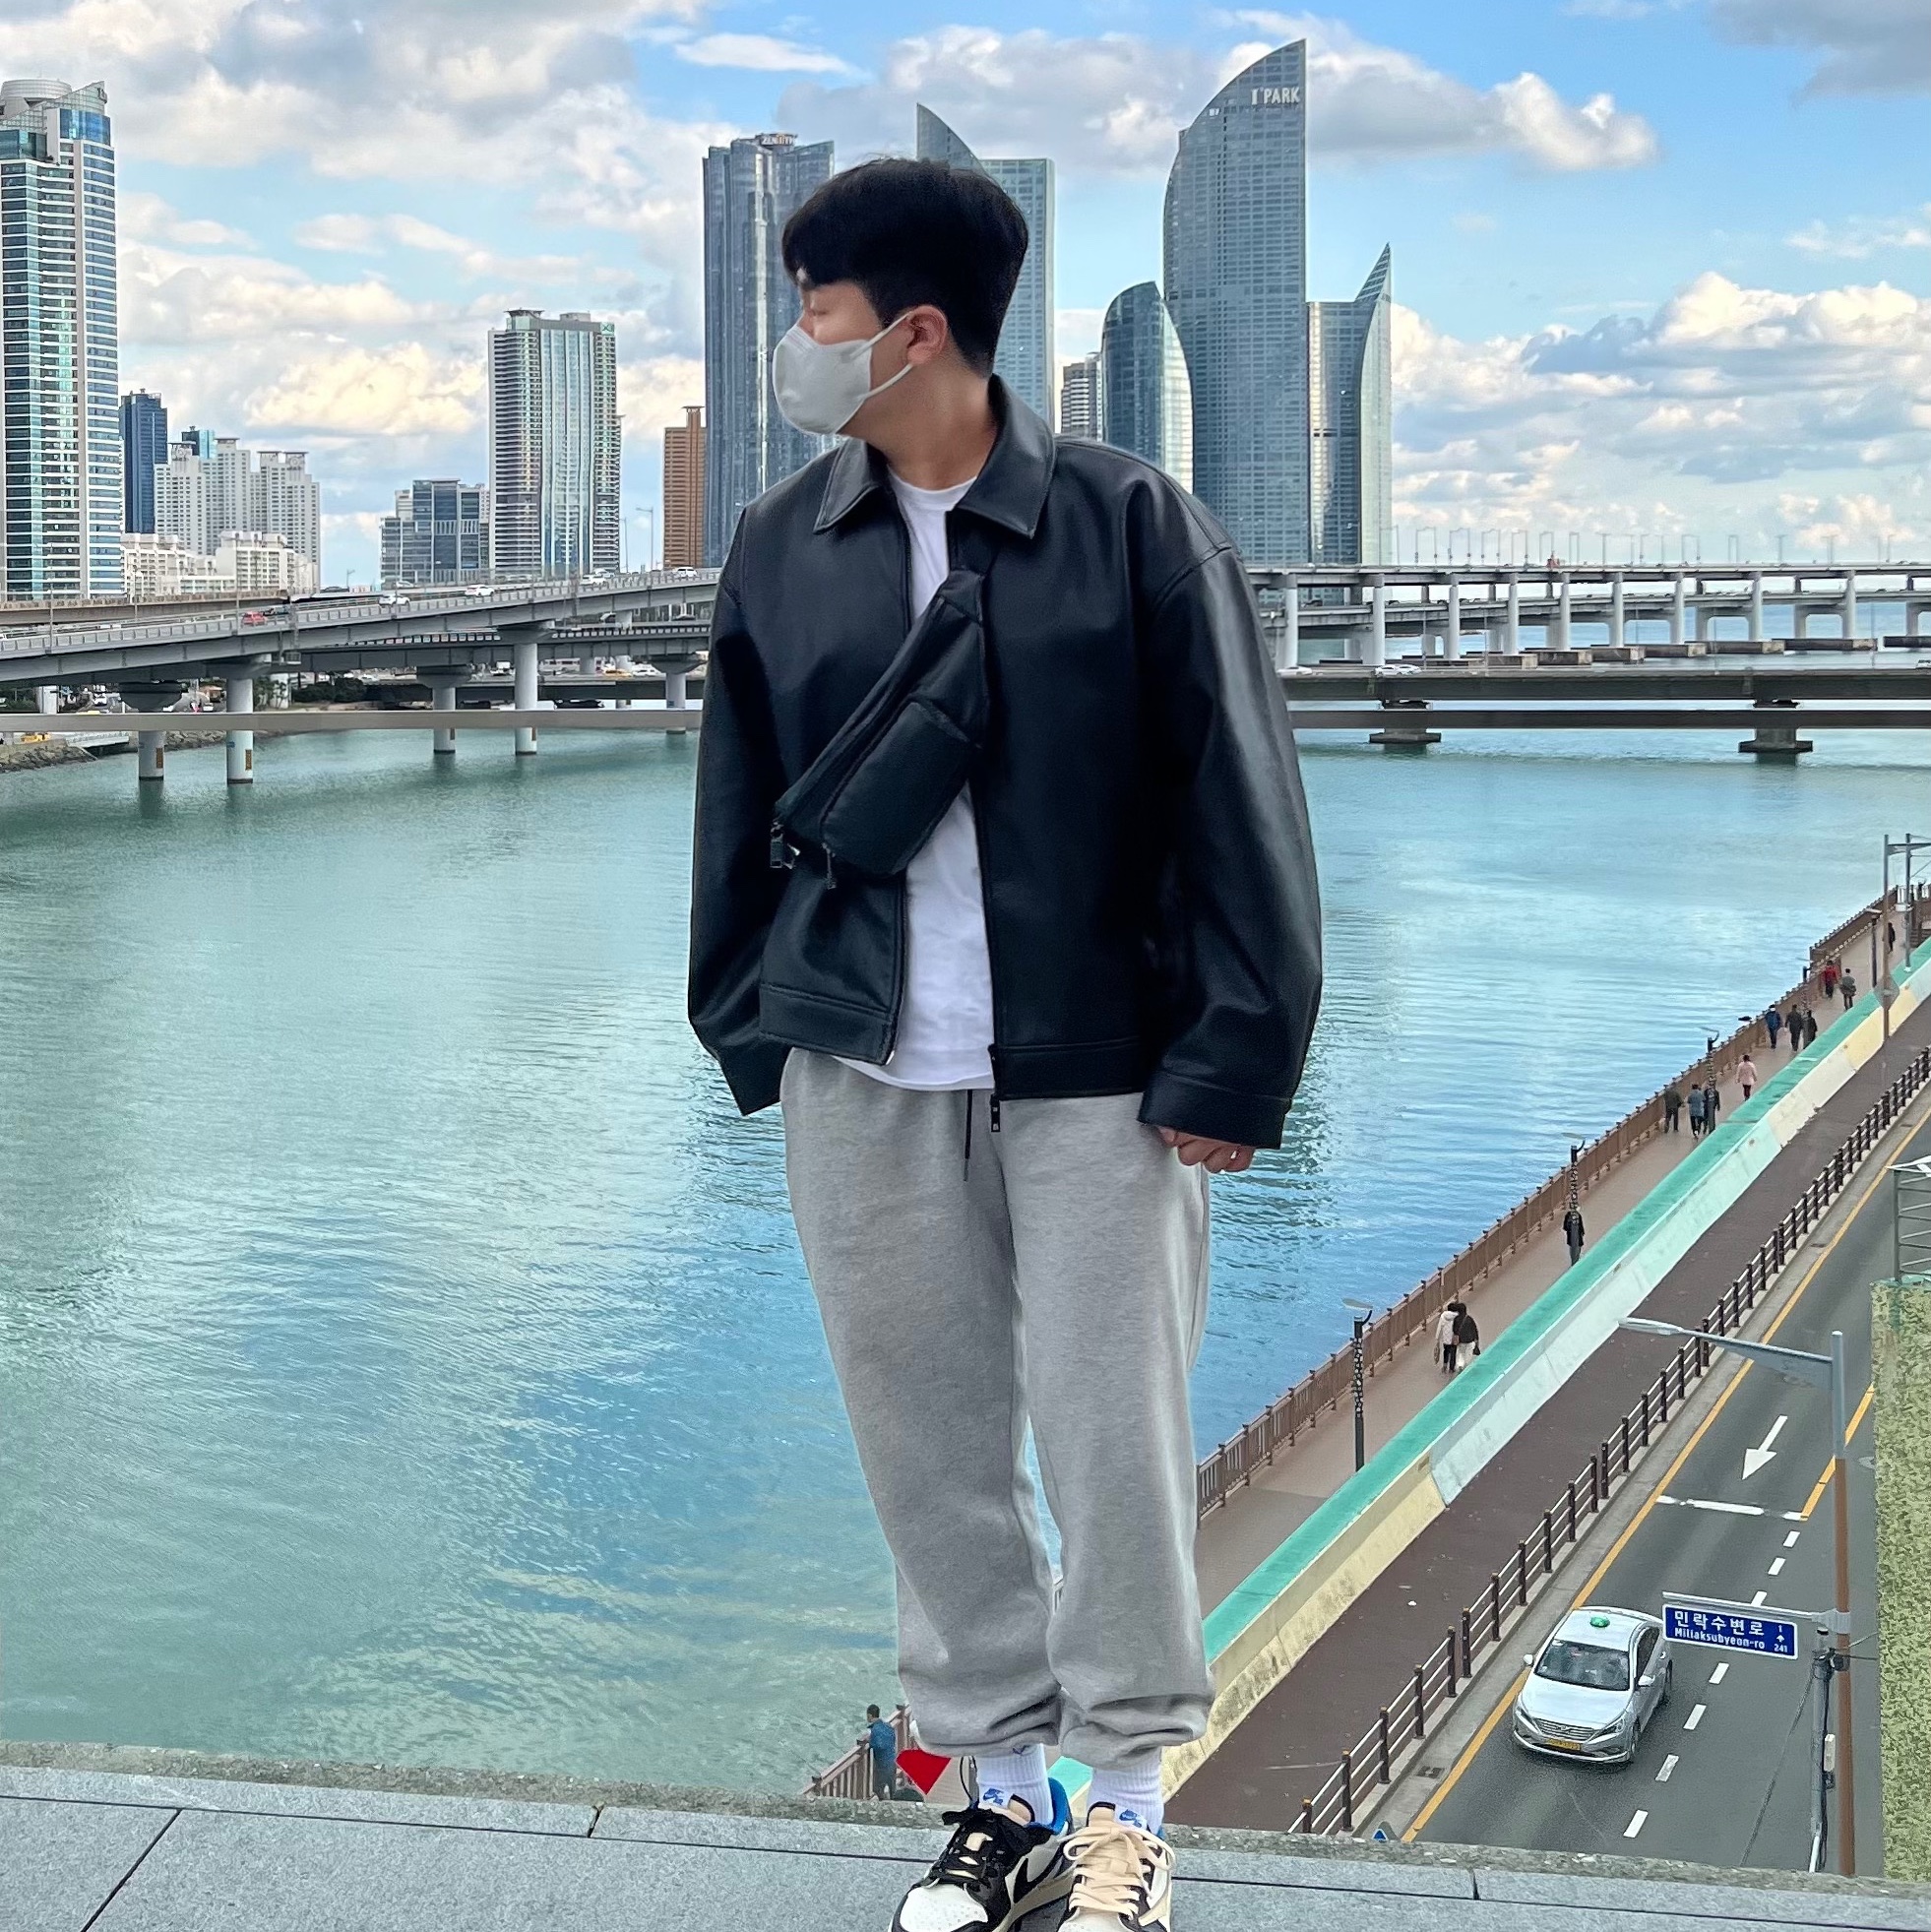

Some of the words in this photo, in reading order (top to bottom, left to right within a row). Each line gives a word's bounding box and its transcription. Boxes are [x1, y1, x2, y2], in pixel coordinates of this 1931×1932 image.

[1674, 1610, 1765, 1636] 민락수변로
[1674, 1627, 1766, 1650] Millaksubyeon-ro
[1774, 1643, 1788, 1653] 241
